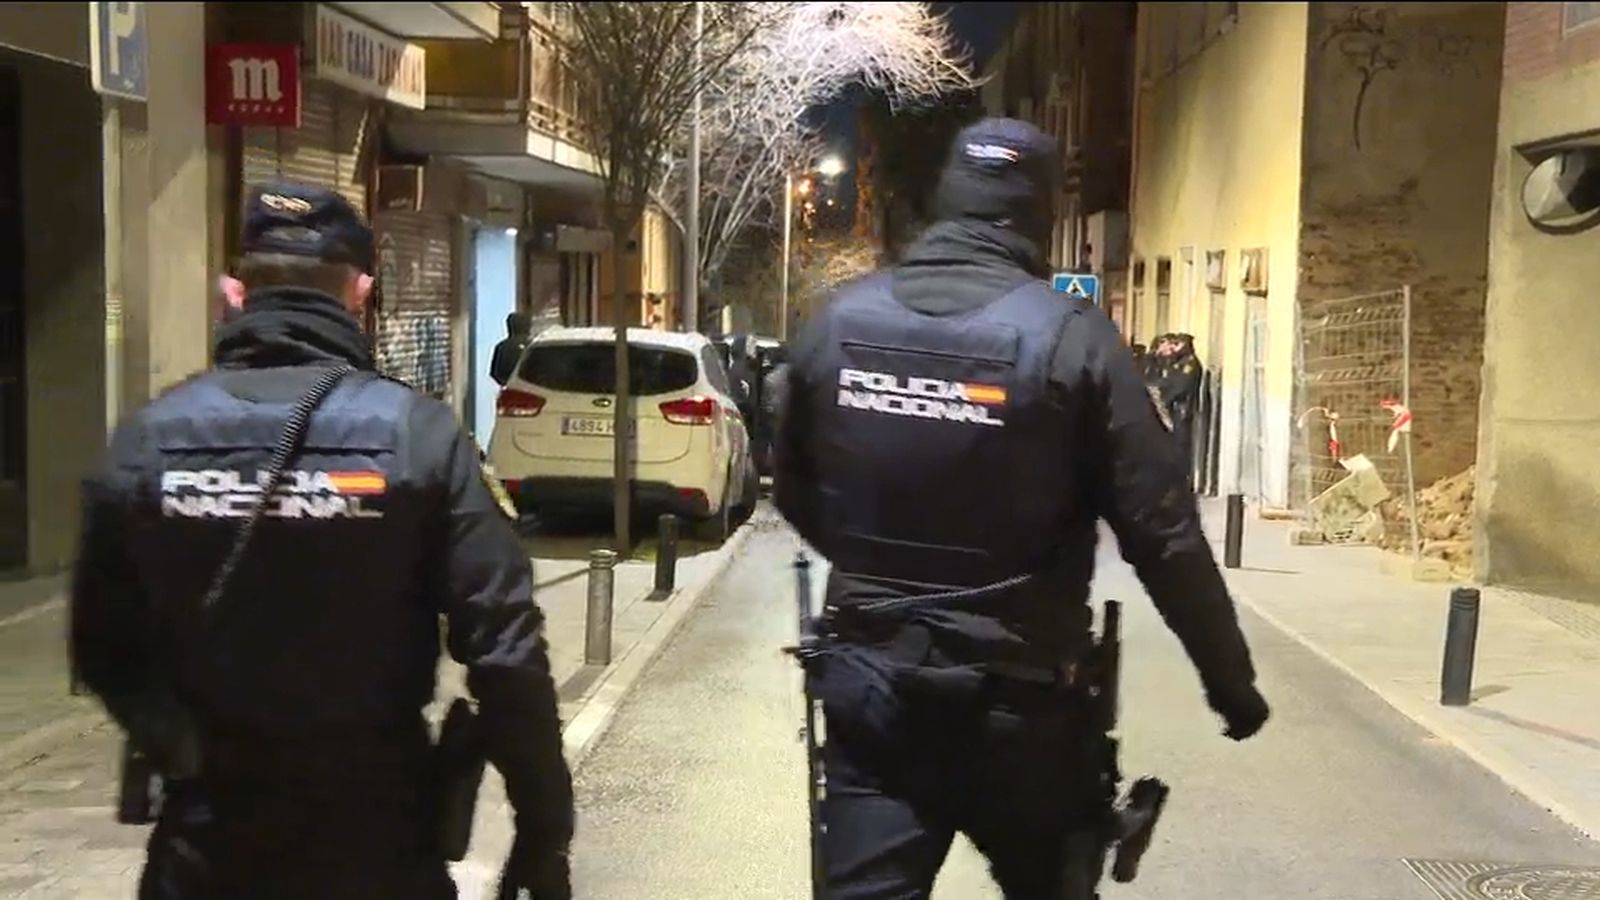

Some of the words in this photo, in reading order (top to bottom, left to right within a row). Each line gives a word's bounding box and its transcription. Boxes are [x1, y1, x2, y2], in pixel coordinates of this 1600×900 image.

[108, 2, 137, 75] P
[839, 367, 971, 402] POLICIA
[837, 388, 1005, 428] NACIONAL
